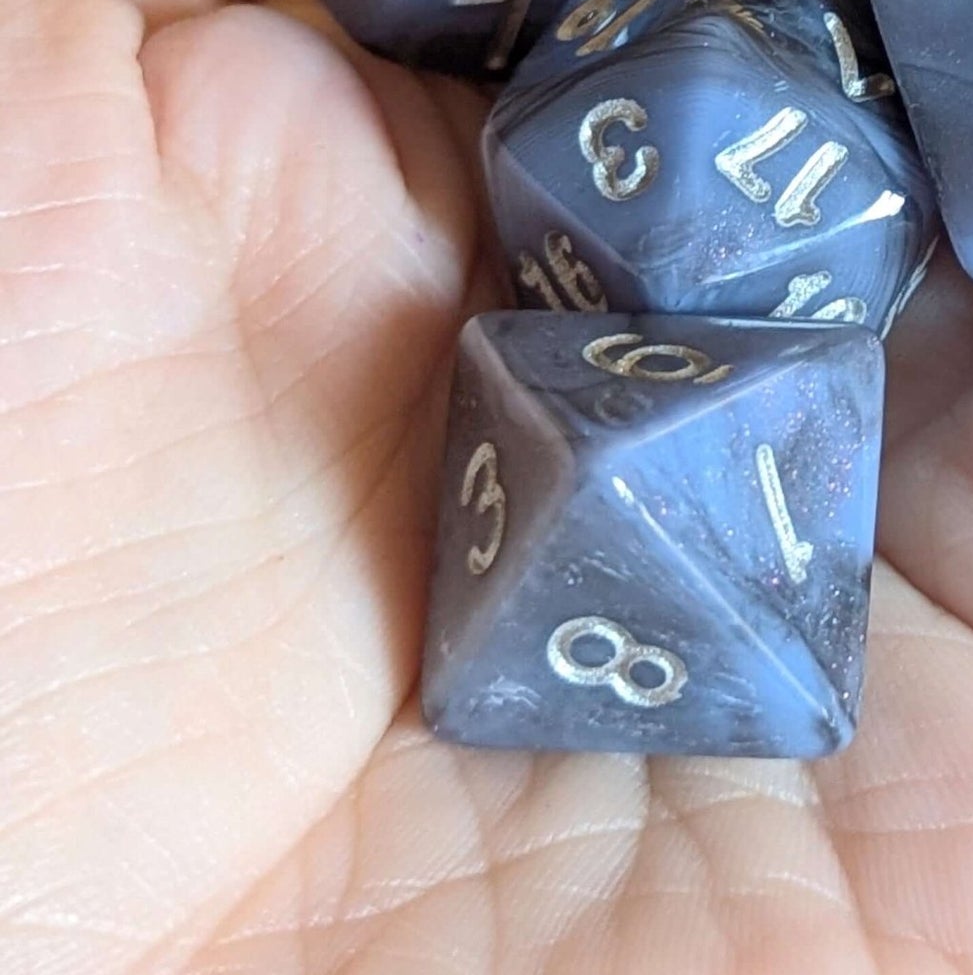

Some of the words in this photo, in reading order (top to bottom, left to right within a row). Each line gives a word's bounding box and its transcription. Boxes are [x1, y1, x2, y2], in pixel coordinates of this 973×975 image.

[578, 97, 662, 203] 3
[714, 105, 851, 228] 17
[459, 441, 506, 577] 3
[755, 441, 814, 584] 1
[546, 615, 689, 709] 8
